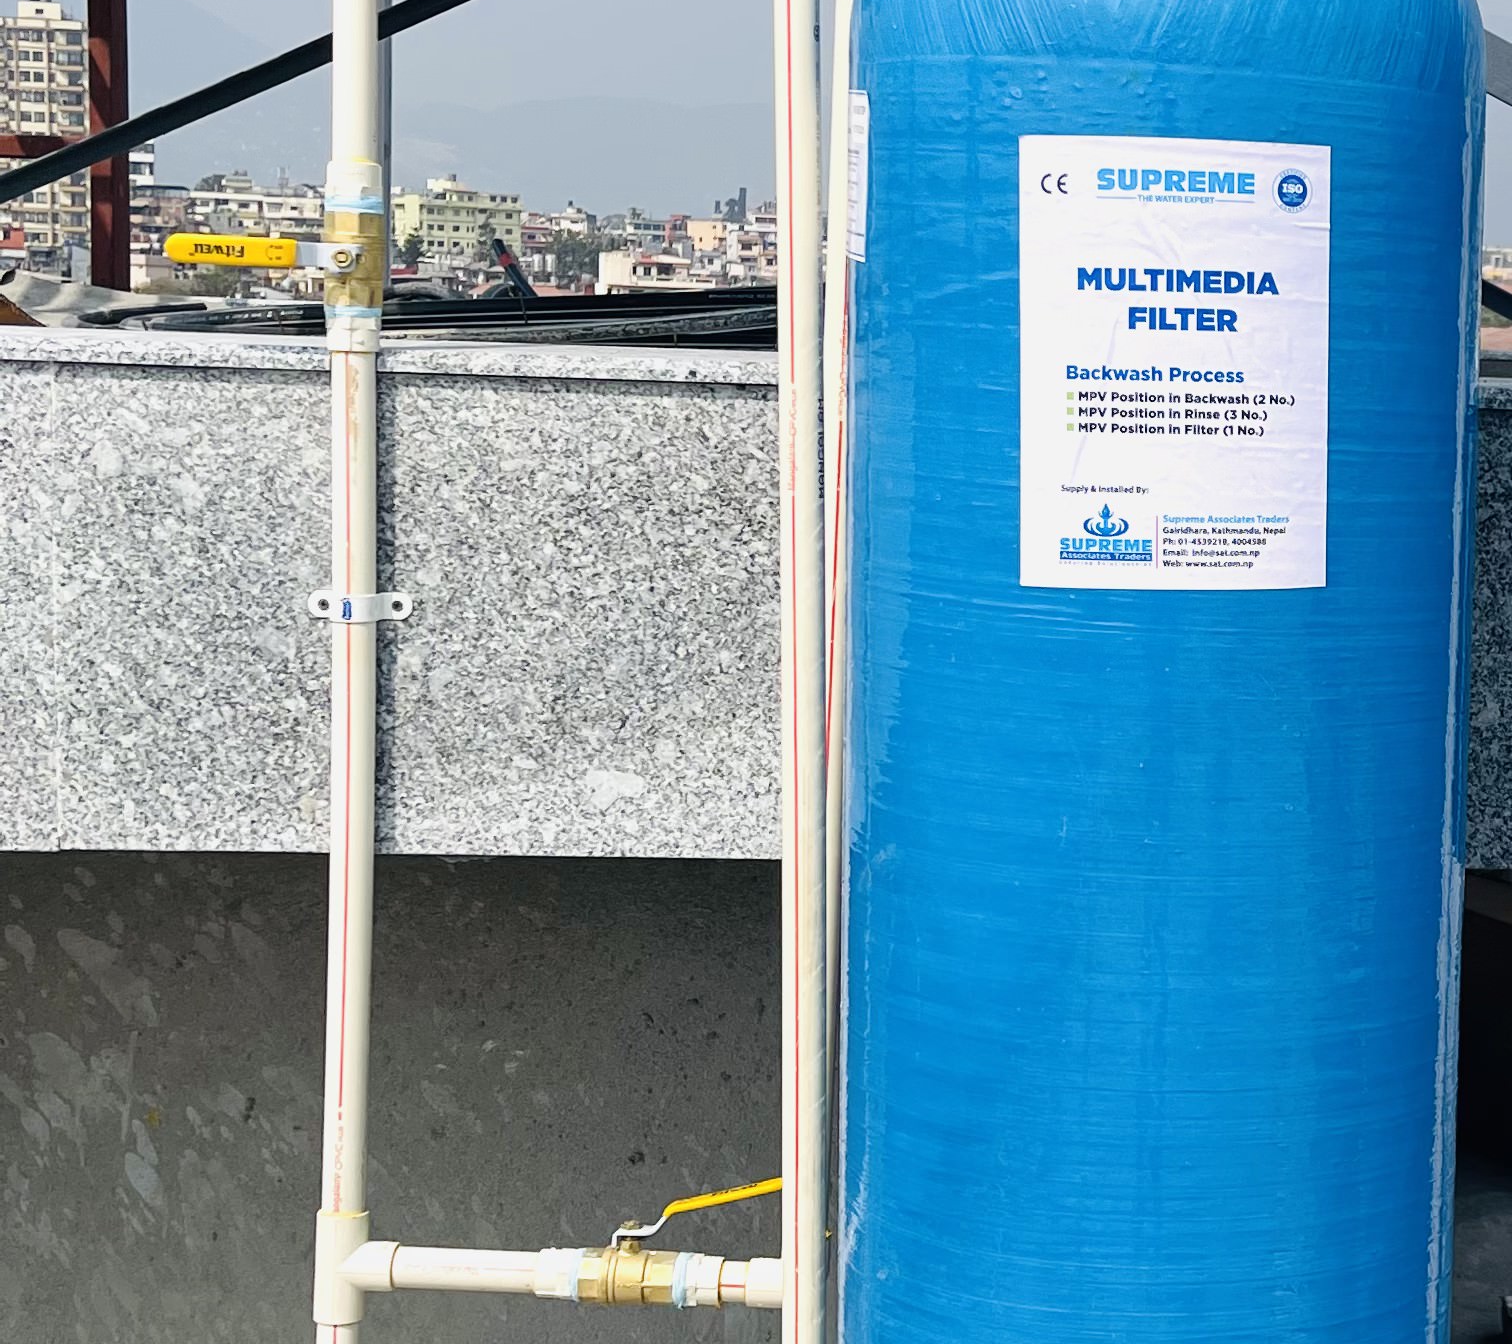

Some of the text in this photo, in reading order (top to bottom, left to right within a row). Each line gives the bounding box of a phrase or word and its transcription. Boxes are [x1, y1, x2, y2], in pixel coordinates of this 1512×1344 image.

[1041, 173, 1068, 194] CE
[1097, 168, 1255, 195] SUPREME
[1282, 183, 1304, 194] ISO
[1137, 194, 1215, 204] THE WATER EXPERT
[1077, 267, 1280, 295] MULTIMEDIA
[1128, 306, 1238, 332] FILTER
[1065, 364, 1245, 383] Backwash Process
[1078, 391, 1295, 407] MPV Position in Backwash (2 No.)
[1078, 407, 1268, 422] MPV Position in Rinse (3 No.)
[1078, 422, 1265, 437] MPV Position in Filter (1 No.)
[1061, 484, 1089, 494] Supply
[1099, 485, 1134, 493] Installed
[1163, 515, 1289, 524] Supreme Associates Traders
[1263, 526, 1286, 536] Nepal
[1060, 537, 1153, 552] SUPREME
[1062, 551, 1151, 561] Associates Traders
